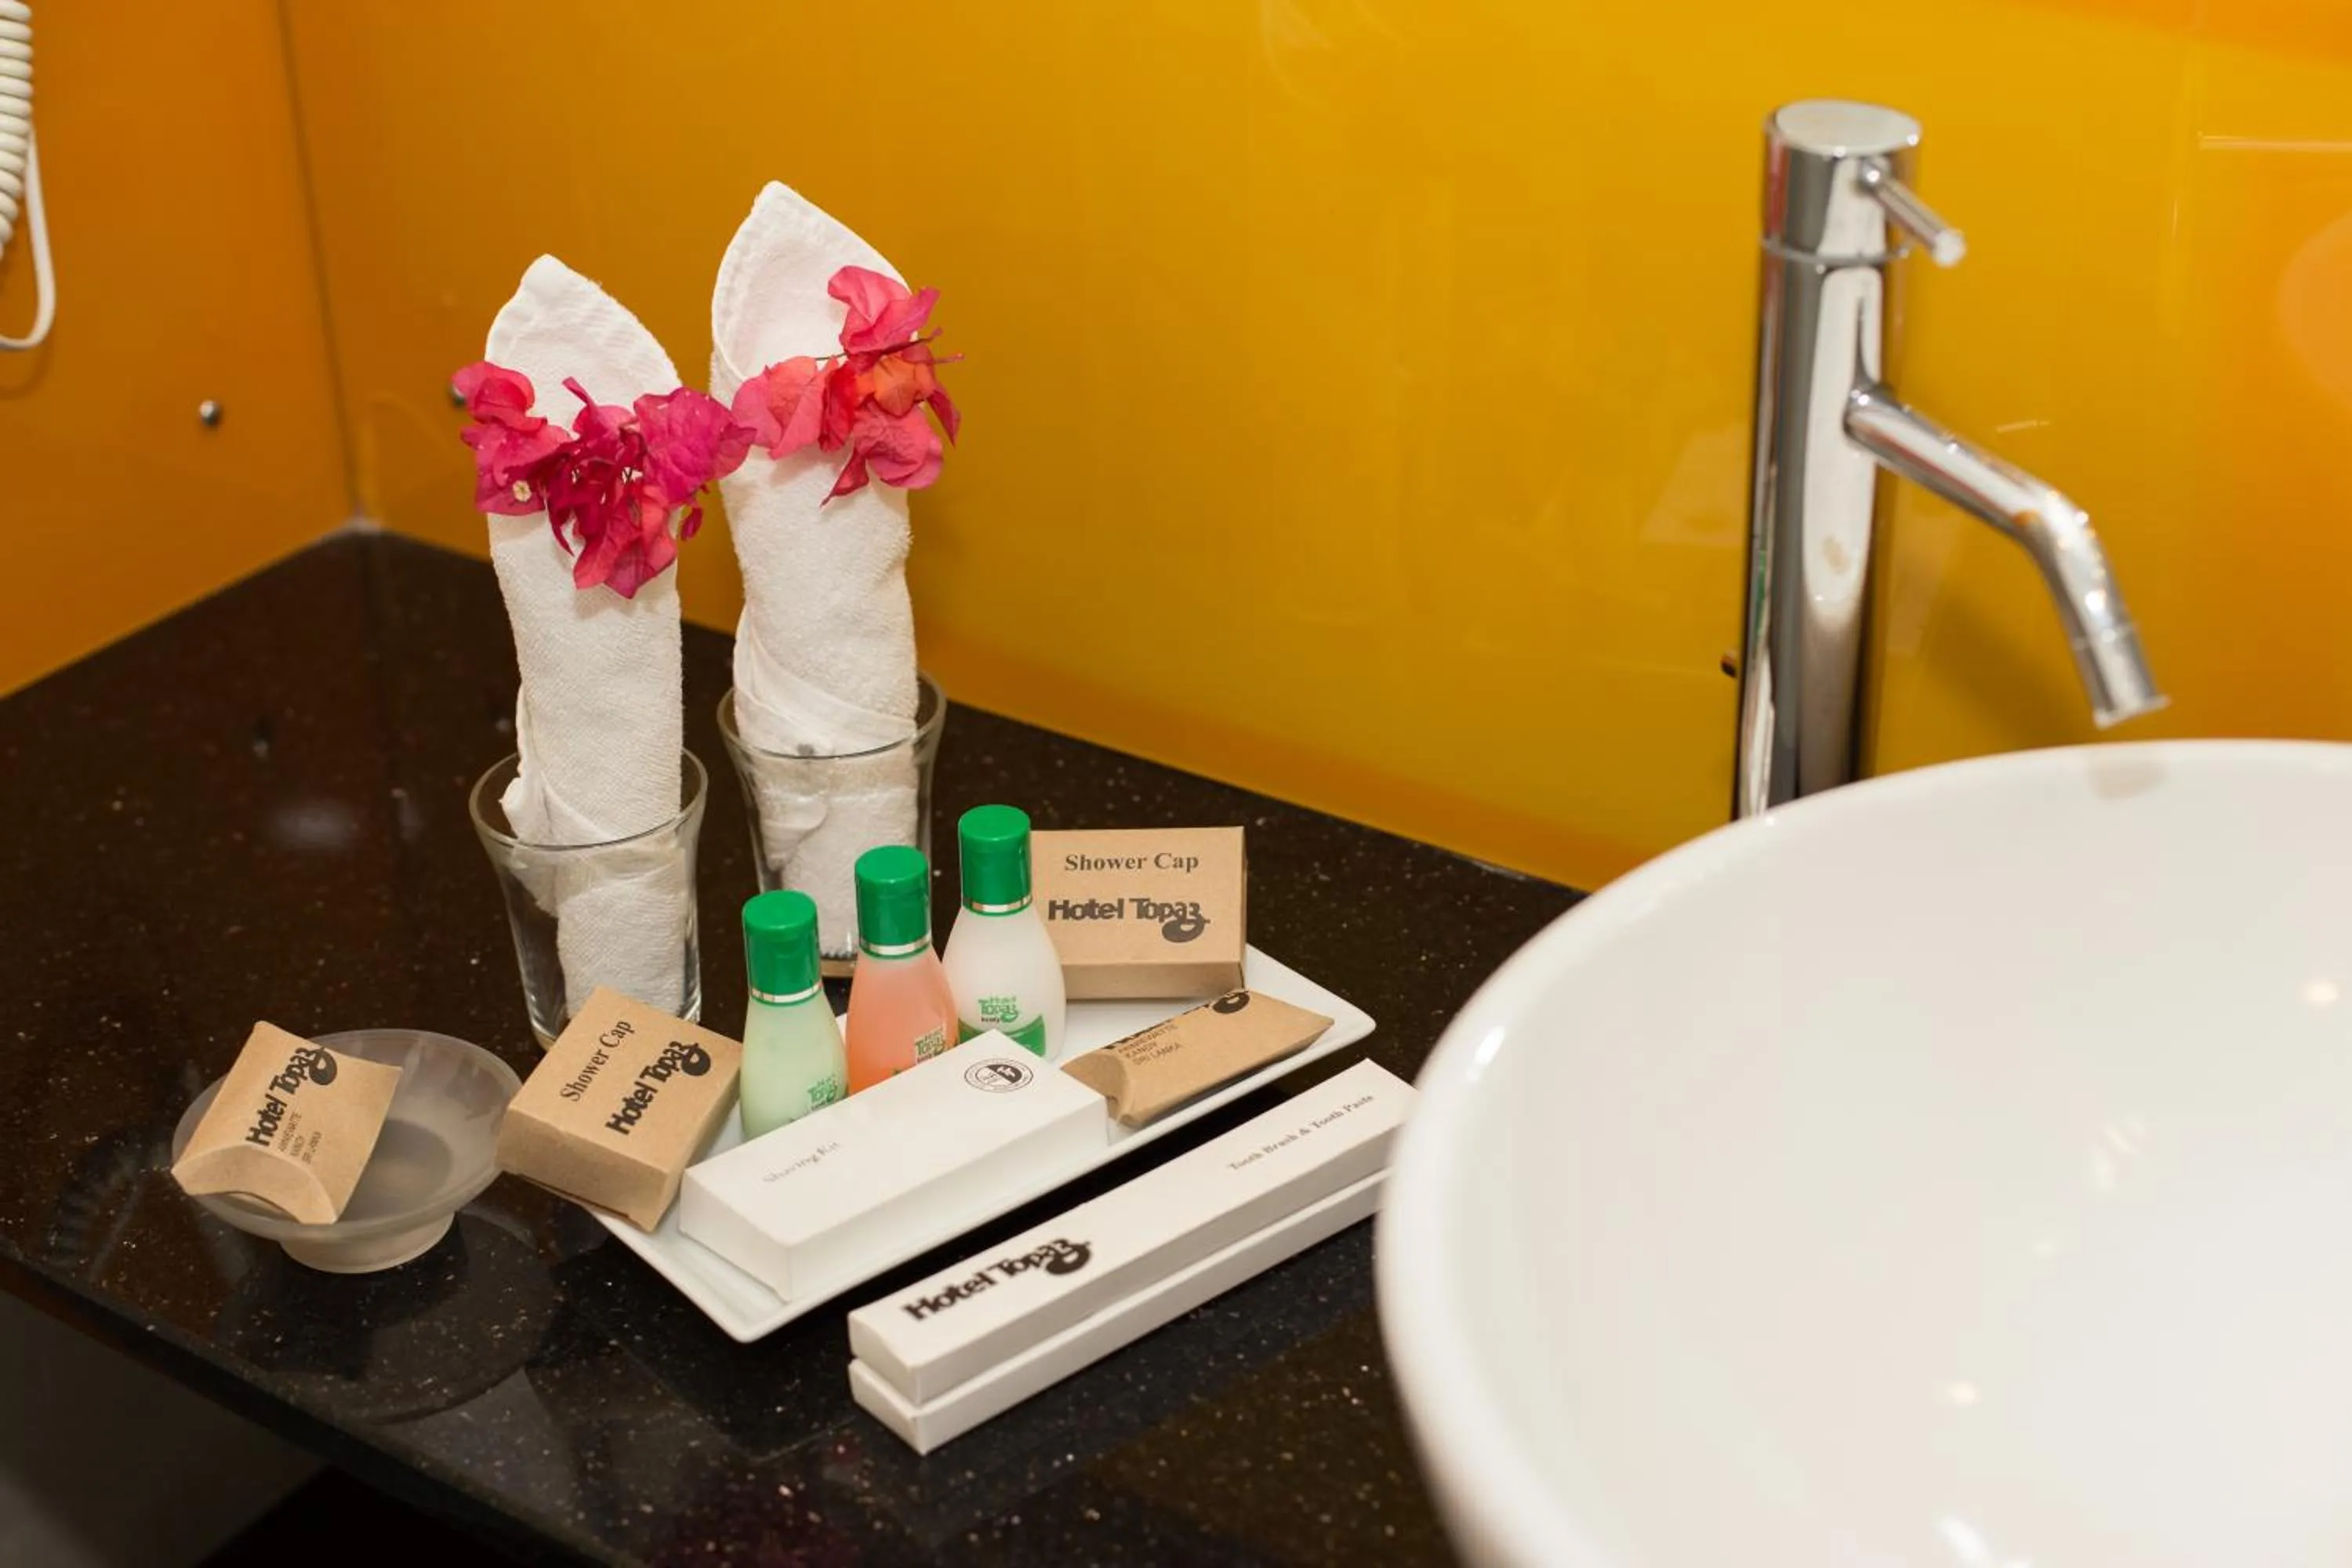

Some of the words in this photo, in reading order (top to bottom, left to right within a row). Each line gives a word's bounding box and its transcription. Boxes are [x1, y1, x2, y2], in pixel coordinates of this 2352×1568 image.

[1064, 853, 1147, 872] Shower
[1154, 852, 1199, 873] Cap
[1047, 898, 1124, 921] Hotel
[1129, 898, 1210, 943] Topaz
[560, 1048, 610, 1102] Shower
[599, 1020, 635, 1048] Cap
[245, 1094, 288, 1146] Hotel
[604, 1081, 658, 1135] Hotel
[1228, 1151, 1264, 1171] Tooth
[1262, 1134, 1298, 1154] Brush
[1298, 1127, 1312, 1137] &
[1311, 1109, 1345, 1129] Tooth
[1341, 1095, 1374, 1113] Paste
[901, 1272, 998, 1321] Hotel
